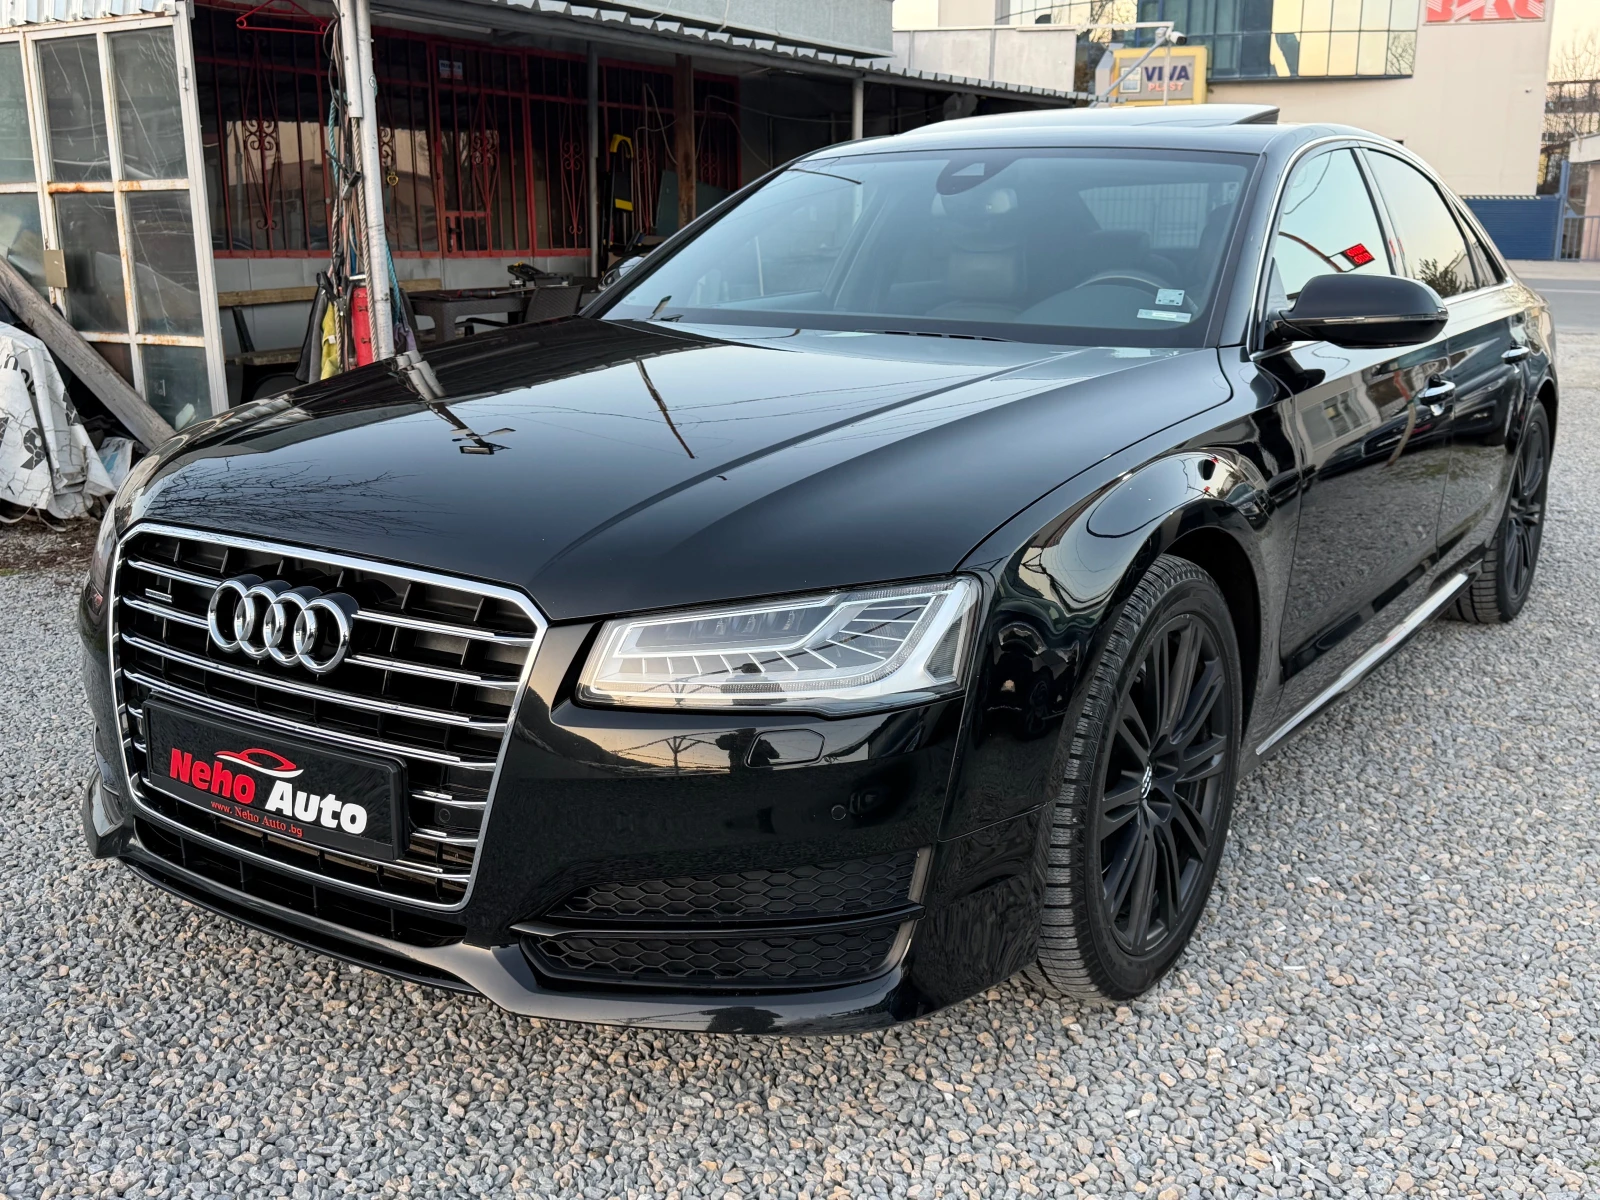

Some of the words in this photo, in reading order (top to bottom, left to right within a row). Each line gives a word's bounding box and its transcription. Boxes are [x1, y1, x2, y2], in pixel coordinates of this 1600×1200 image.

[169, 747, 256, 804] Neho
[264, 780, 367, 834] Auto
[234, 806, 259, 823] Neho
[261, 817, 287, 831] Auto
